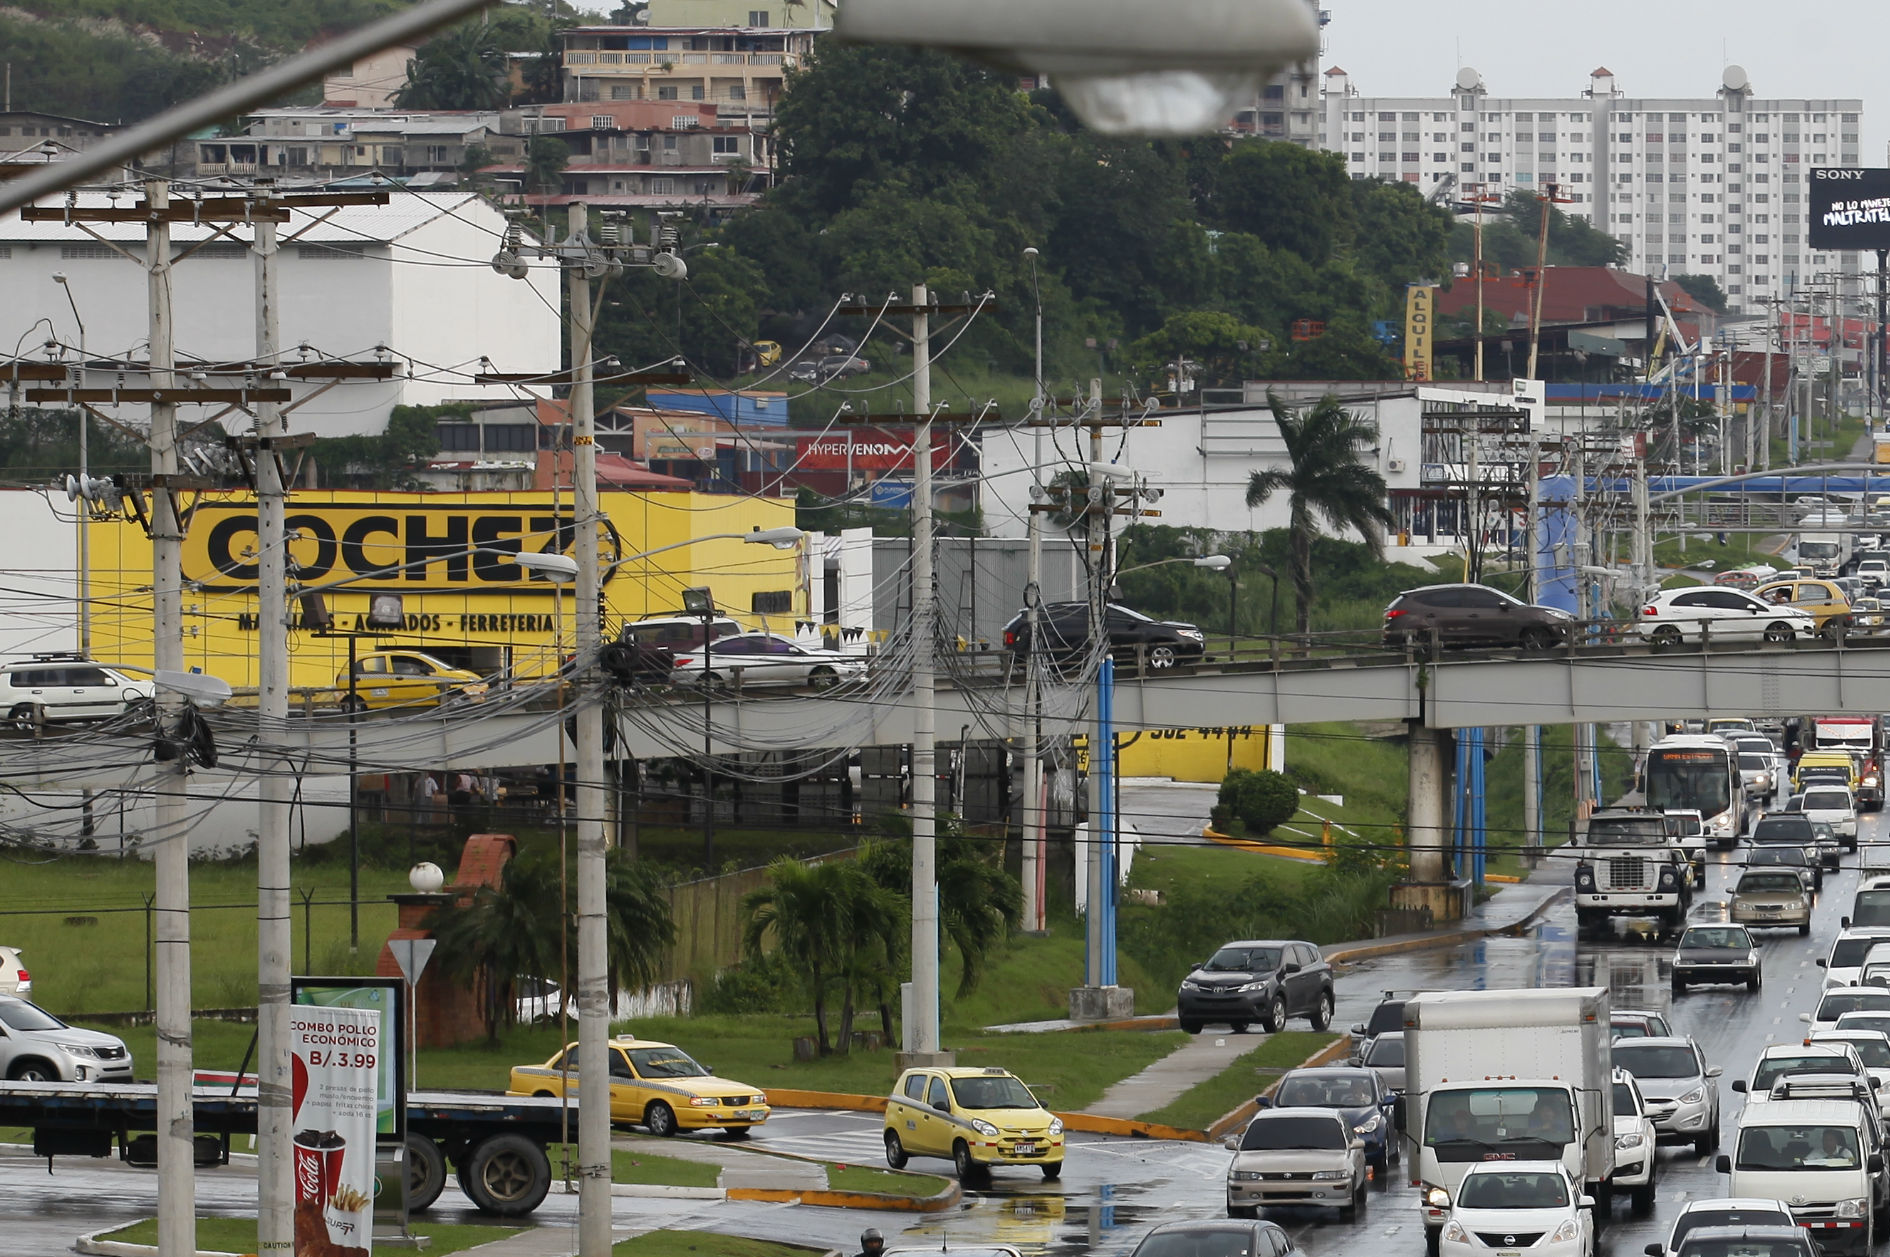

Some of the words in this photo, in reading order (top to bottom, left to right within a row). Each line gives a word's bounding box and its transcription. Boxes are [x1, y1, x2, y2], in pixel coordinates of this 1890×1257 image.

[1816, 169, 1865, 180] SONY
[1831, 202, 1844, 211] NO
[1847, 201, 1858, 210] LO
[460, 613, 554, 633] FERRETERIA
[338, 1023, 377, 1037] POLLO
[303, 1033, 377, 1048] ECONÓMICO
[310, 1051, 377, 1069] B/.3.99
